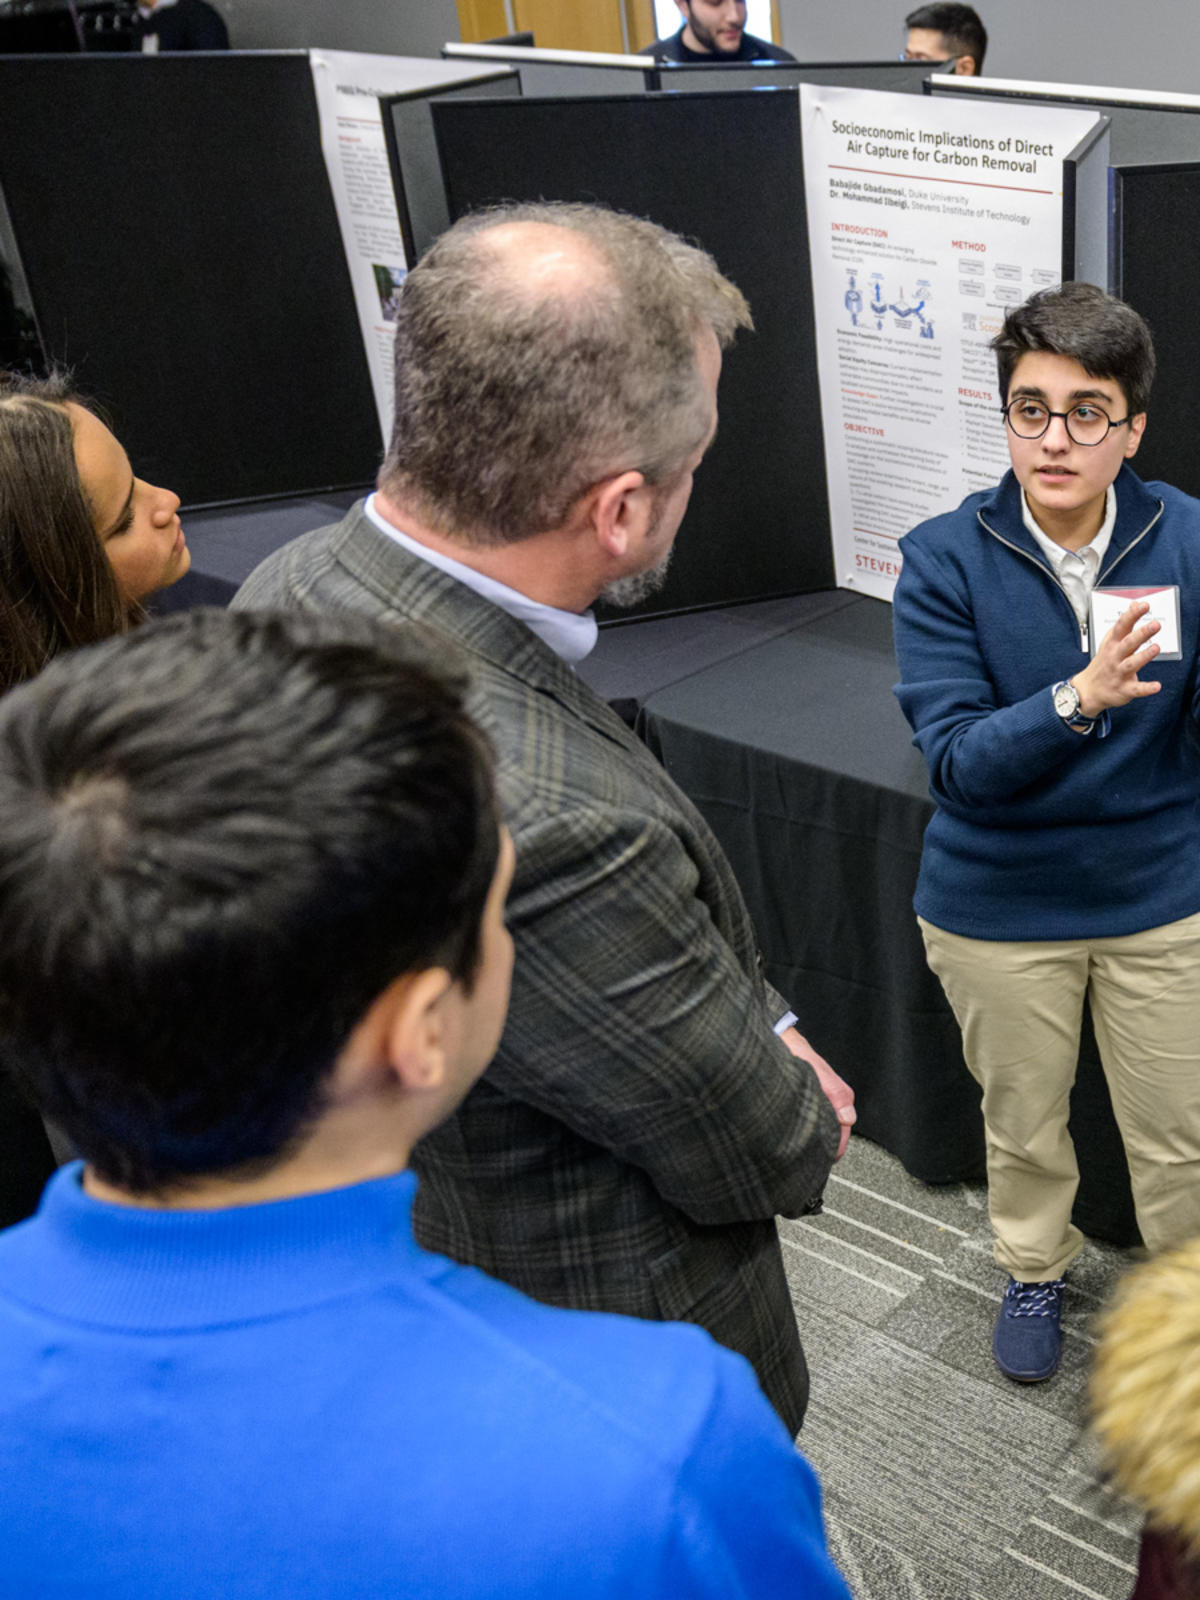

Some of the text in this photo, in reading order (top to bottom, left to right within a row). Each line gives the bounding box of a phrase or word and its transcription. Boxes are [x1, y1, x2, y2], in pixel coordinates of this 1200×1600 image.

[832, 121, 1053, 156] Socioeconomic Implications of Direct
[847, 140, 1036, 172] Air Capture for Carbon Removal
[908, 189, 928, 200] Duke
[930, 193, 969, 205] University
[829, 189, 842, 198] Dr.
[842, 192, 883, 204] Mohammad
[912, 201, 940, 212] Stevens
[942, 205, 975, 216] Institute
[976, 209, 985, 218] of
[987, 210, 1031, 225] Technology
[831, 223, 888, 237] INTRODUCTION
[952, 240, 986, 252] METHOD
[958, 387, 992, 400] RESULTS
[844, 423, 884, 436] OBJECTIVE
